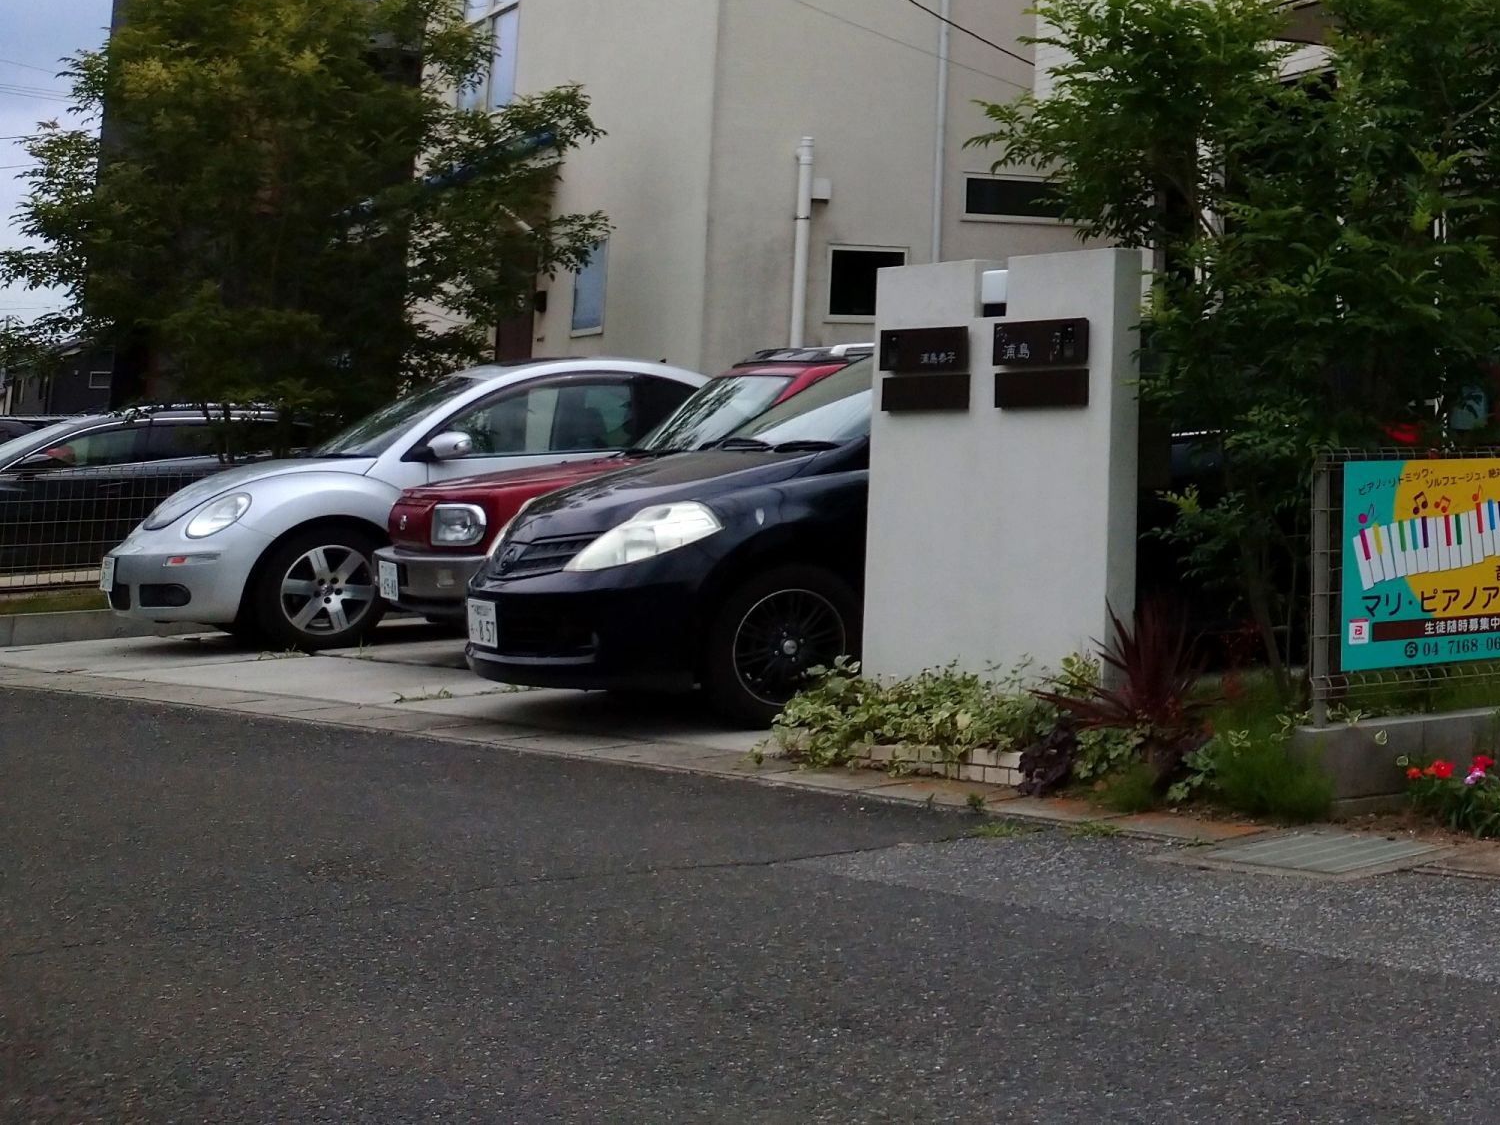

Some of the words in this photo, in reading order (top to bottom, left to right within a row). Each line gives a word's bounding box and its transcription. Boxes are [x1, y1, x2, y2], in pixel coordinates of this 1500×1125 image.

[1424, 616, 1500, 635] 生徒随時募集中
